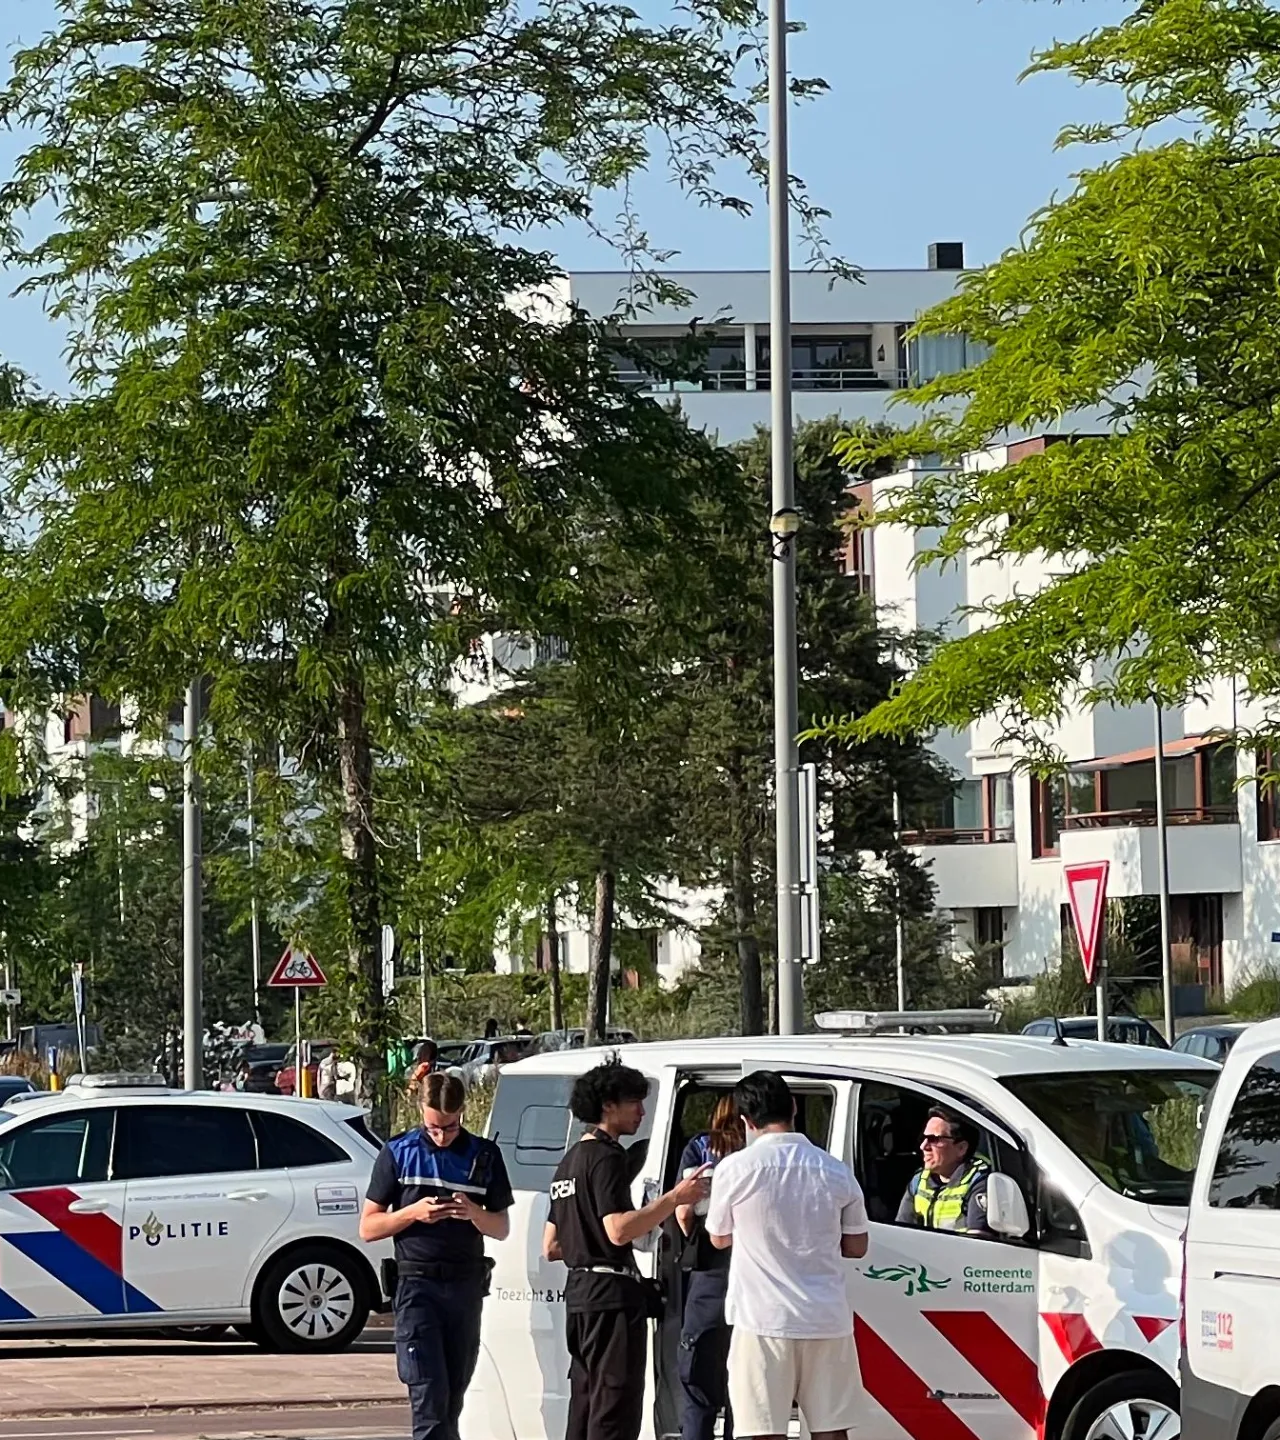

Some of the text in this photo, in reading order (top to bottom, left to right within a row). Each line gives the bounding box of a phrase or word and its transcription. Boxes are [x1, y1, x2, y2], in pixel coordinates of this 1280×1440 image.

[129, 1221, 228, 1246] POLITIE
[963, 1266, 1033, 1279] Gemeente
[963, 1281, 1035, 1293] Rotterdam
[496, 1288, 544, 1302] Toezicht
[545, 1289, 555, 1303] &
[1217, 1312, 1233, 1336] 112
